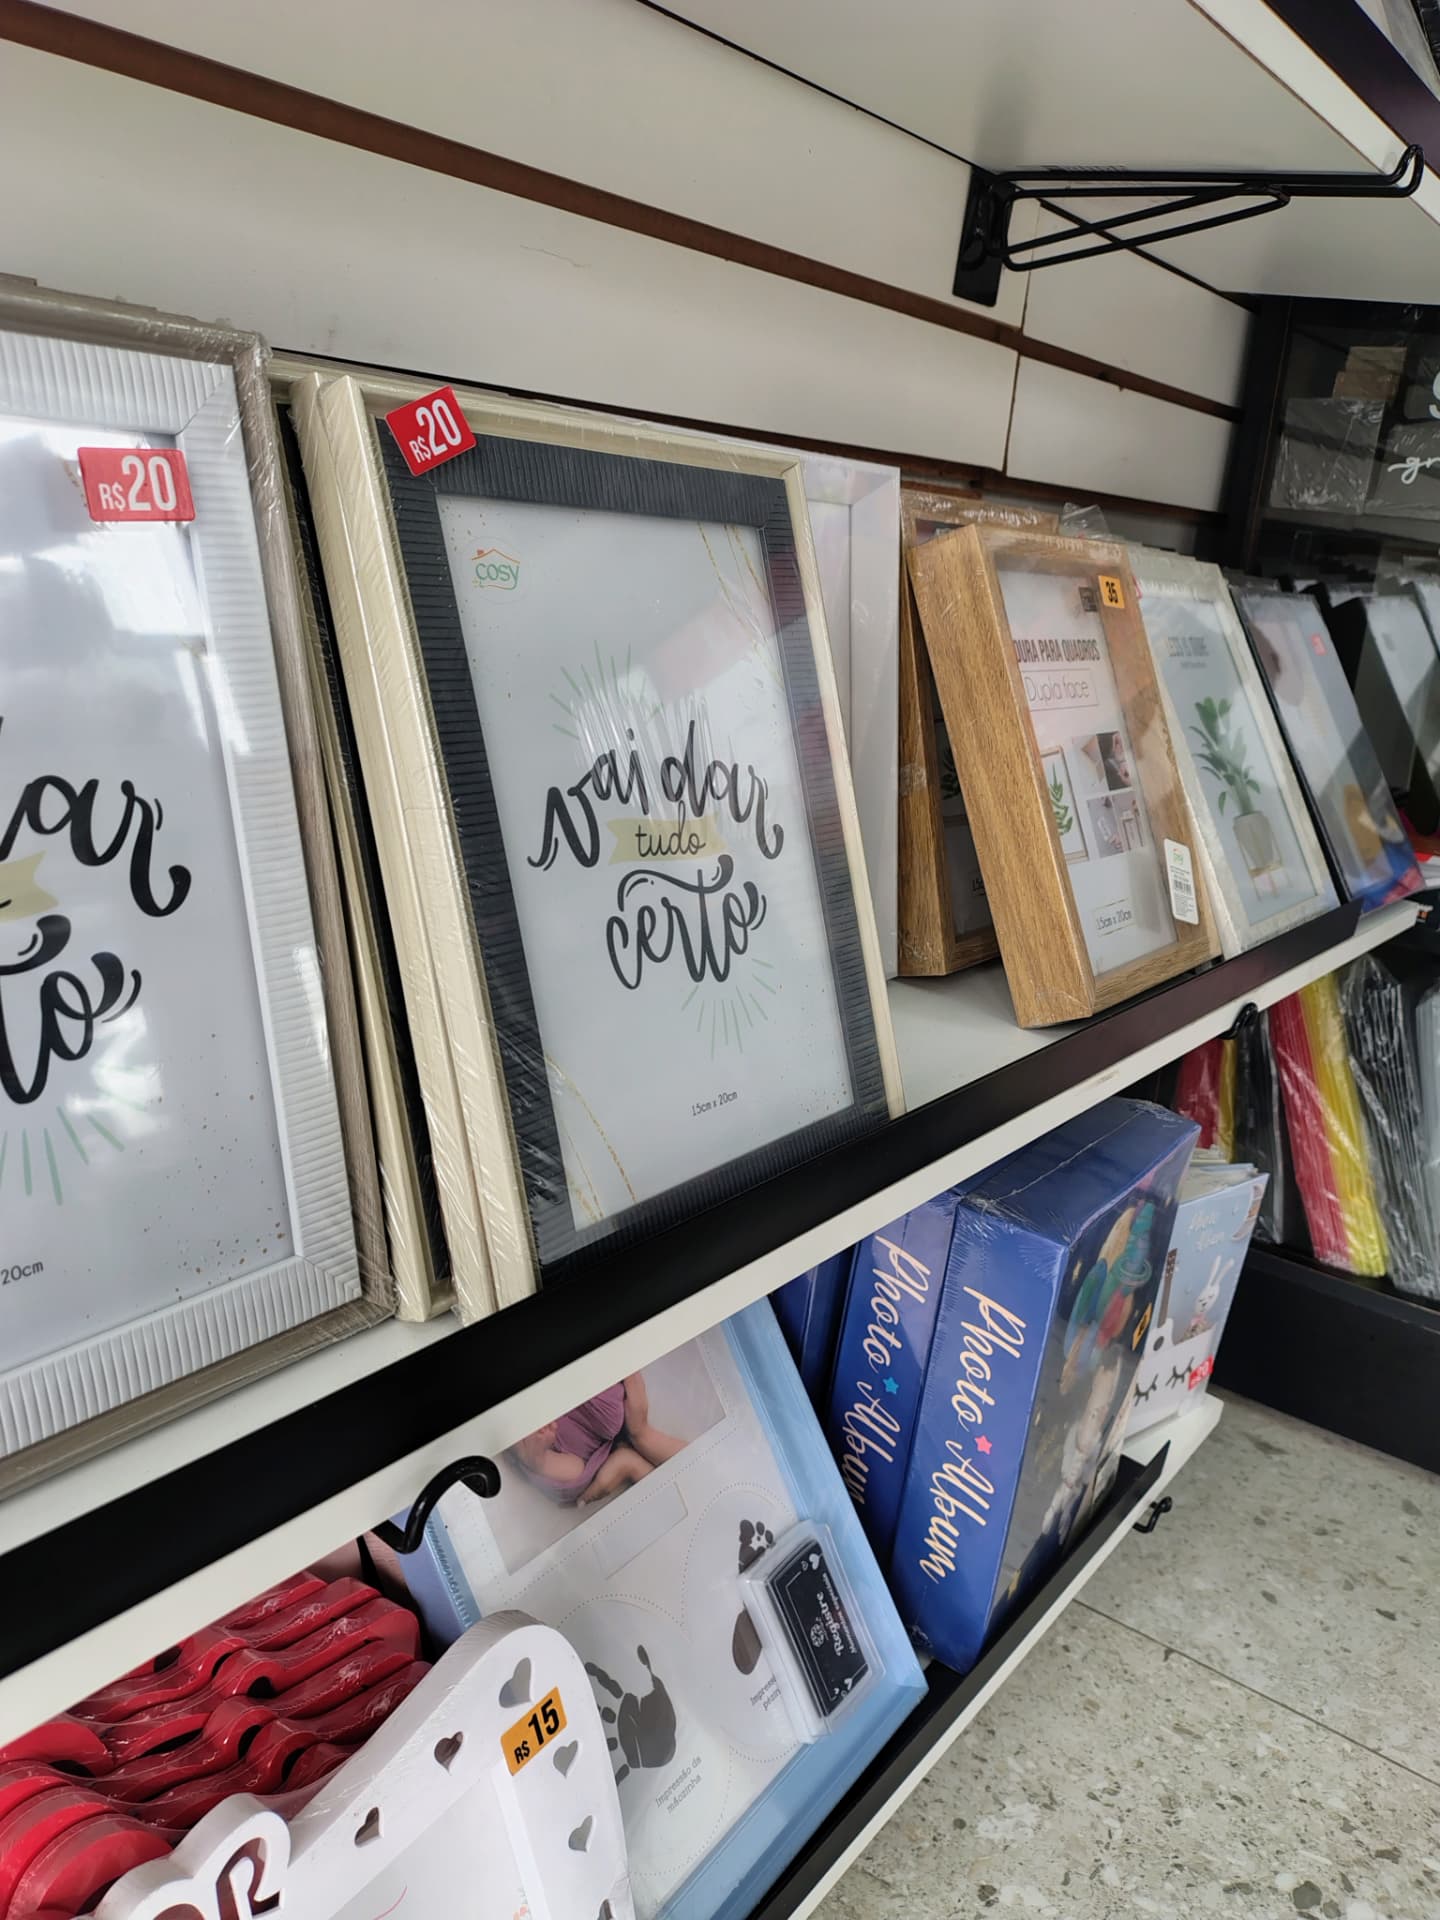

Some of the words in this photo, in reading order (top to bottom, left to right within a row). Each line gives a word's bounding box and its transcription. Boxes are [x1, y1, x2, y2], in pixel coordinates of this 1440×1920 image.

[1105, 581, 1118, 603] 35
[1023, 675, 1062, 705] Dupla
[1038, 639, 1062, 661] PARA
[1061, 639, 1101, 660] QUADROS
[527, 728, 648, 871] vai
[660, 719, 784, 859] dar
[635, 800, 706, 857] tudo
[0, 774, 191, 917] ar
[606, 854, 767, 990] certo
[691, 1102, 712, 1116] 15cm
[718, 1091, 738, 1105] 20cm
[1, 1261, 43, 1284] 20cm
[861, 1235, 931, 1374] Photo
[952, 1286, 1026, 1432] Photo
[919, 1440, 995, 1584] Album
